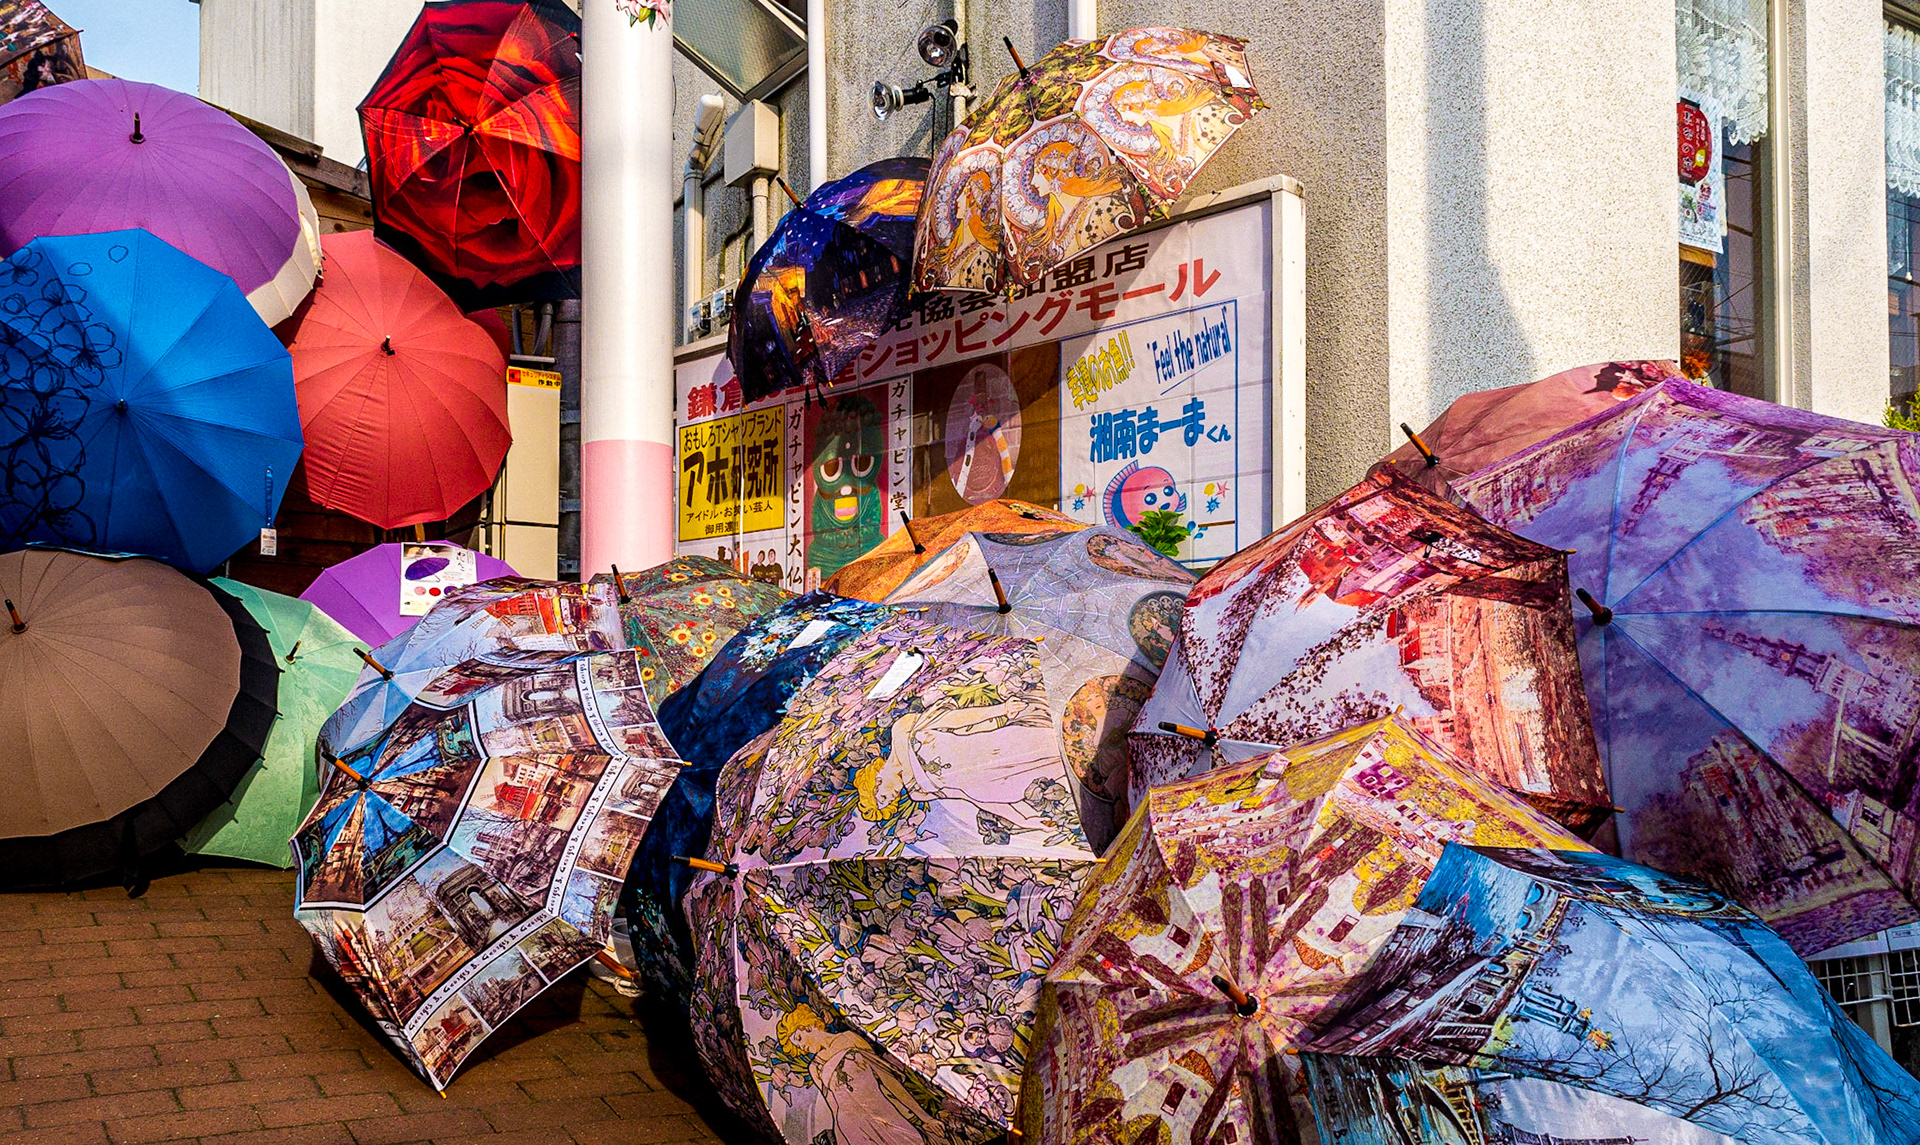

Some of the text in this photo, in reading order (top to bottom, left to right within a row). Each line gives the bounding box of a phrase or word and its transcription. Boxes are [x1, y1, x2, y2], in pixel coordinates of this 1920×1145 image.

[686, 257, 1222, 421] 鎌倉ショッピングモール
[1173, 329, 1195, 374] the
[683, 435, 779, 509] アホ研究所
[786, 406, 804, 586] ガチャピン大仏
[890, 379, 908, 511] ガチャピン堂
